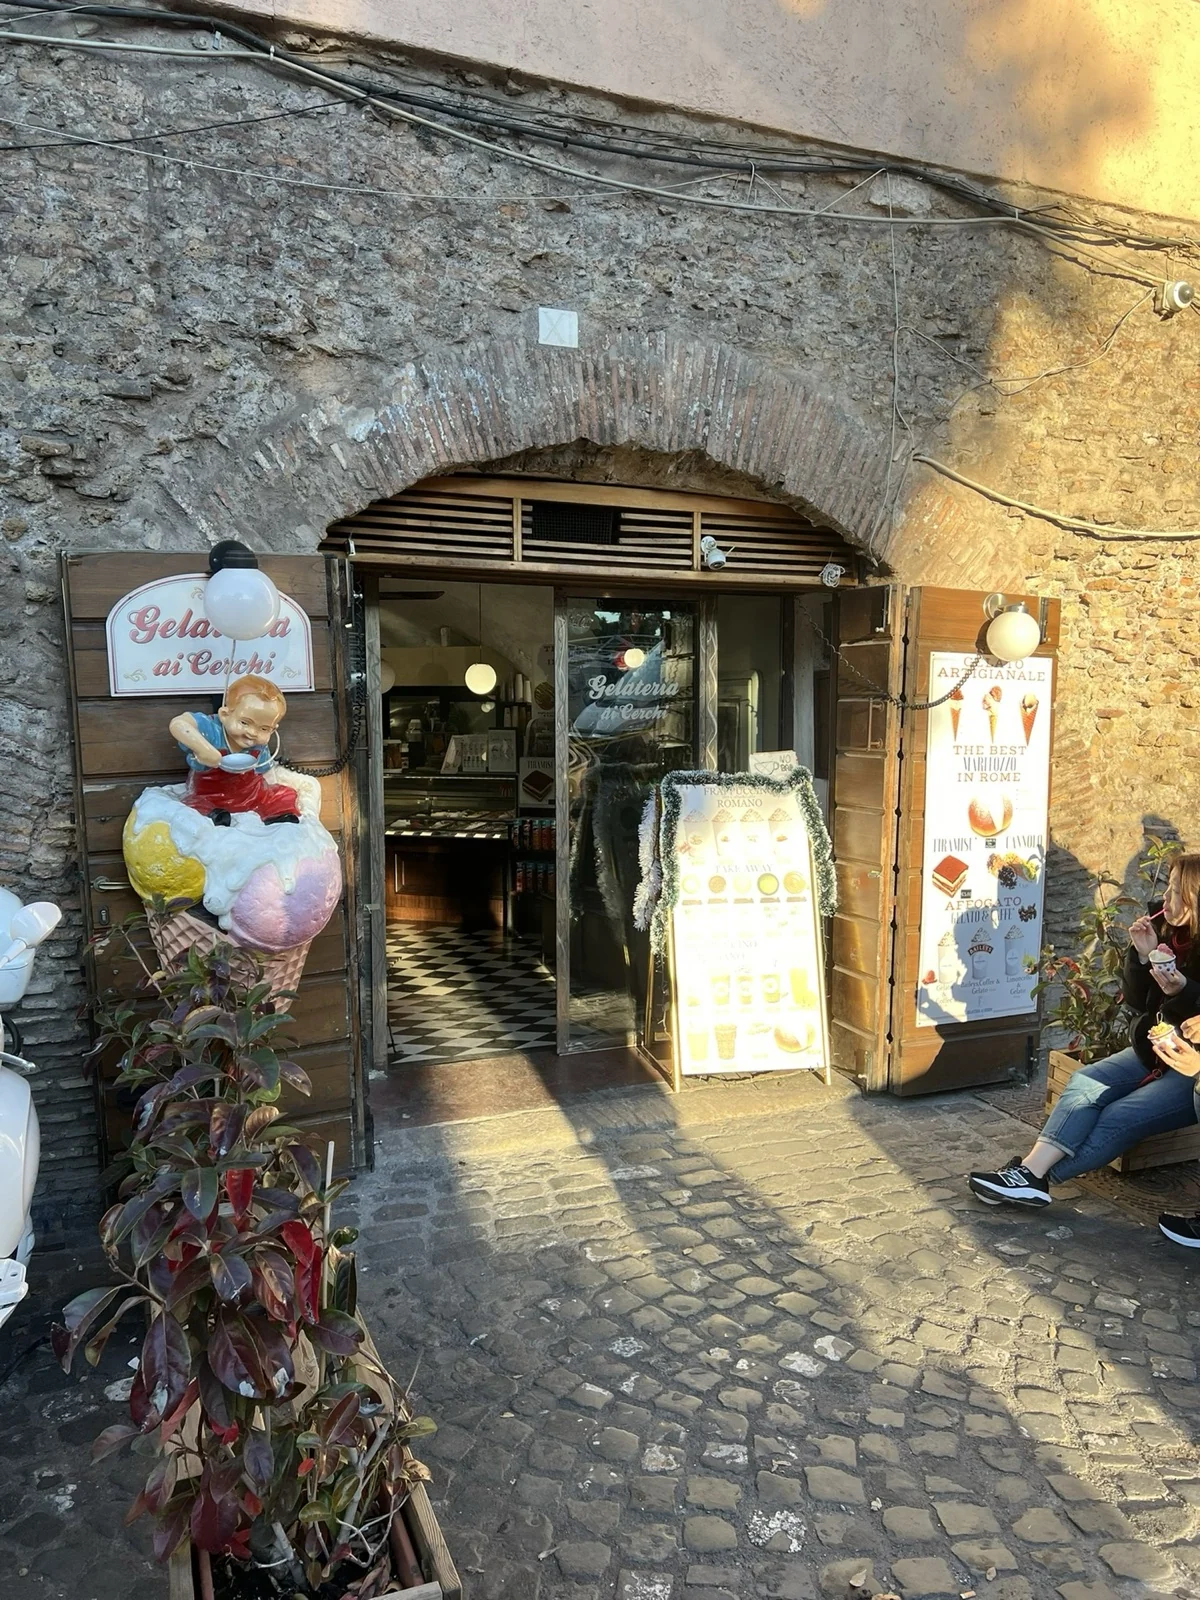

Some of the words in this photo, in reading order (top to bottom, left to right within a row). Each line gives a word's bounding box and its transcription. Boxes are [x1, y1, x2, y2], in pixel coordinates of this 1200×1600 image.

[128, 605, 291, 644] Gelaa
[152, 652, 183, 677] ai
[186, 649, 276, 677] Cerchi
[937, 667, 1046, 682] ARTIGIANALE
[588, 674, 680, 700] Gelateria
[619, 703, 670, 721] Cerchi
[952, 745, 985, 756] THE
[989, 745, 1027, 756] BEST
[779, 754, 791, 763] NO
[962, 756, 1018, 772] MARITOZZO
[957, 772, 974, 782] IN
[979, 772, 1022, 782] ROME
[717, 798, 764, 808] ROMANO
[714, 863, 742, 873] TAKE
[743, 863, 775, 873] AWAY
[945, 897, 1021, 911] AFFOGATO
[982, 911, 990, 923] &
